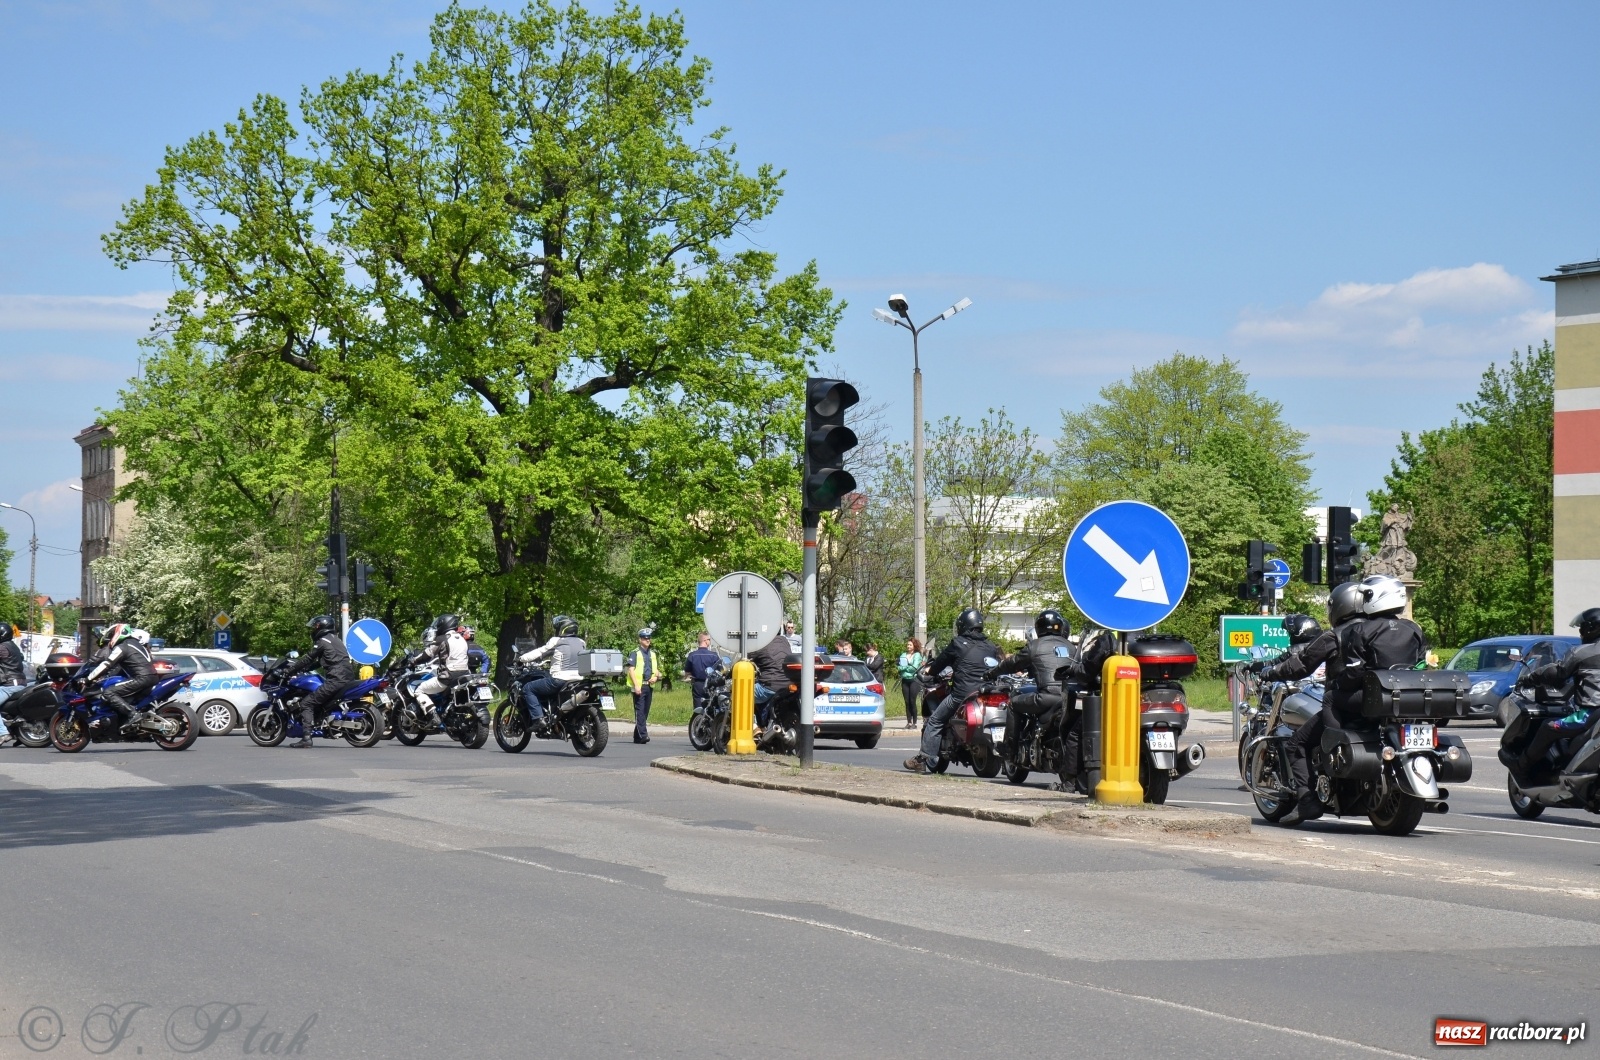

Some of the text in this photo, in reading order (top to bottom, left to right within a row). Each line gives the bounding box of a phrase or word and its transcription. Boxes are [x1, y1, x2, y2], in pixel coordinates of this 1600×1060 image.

[1262, 623, 1290, 640] Pszcz
[217, 632, 228, 645] P
[1234, 633, 1250, 645] 935
[1413, 726, 1425, 736] OK
[1152, 741, 1174, 749] 986A
[1406, 737, 1431, 747] 982A
